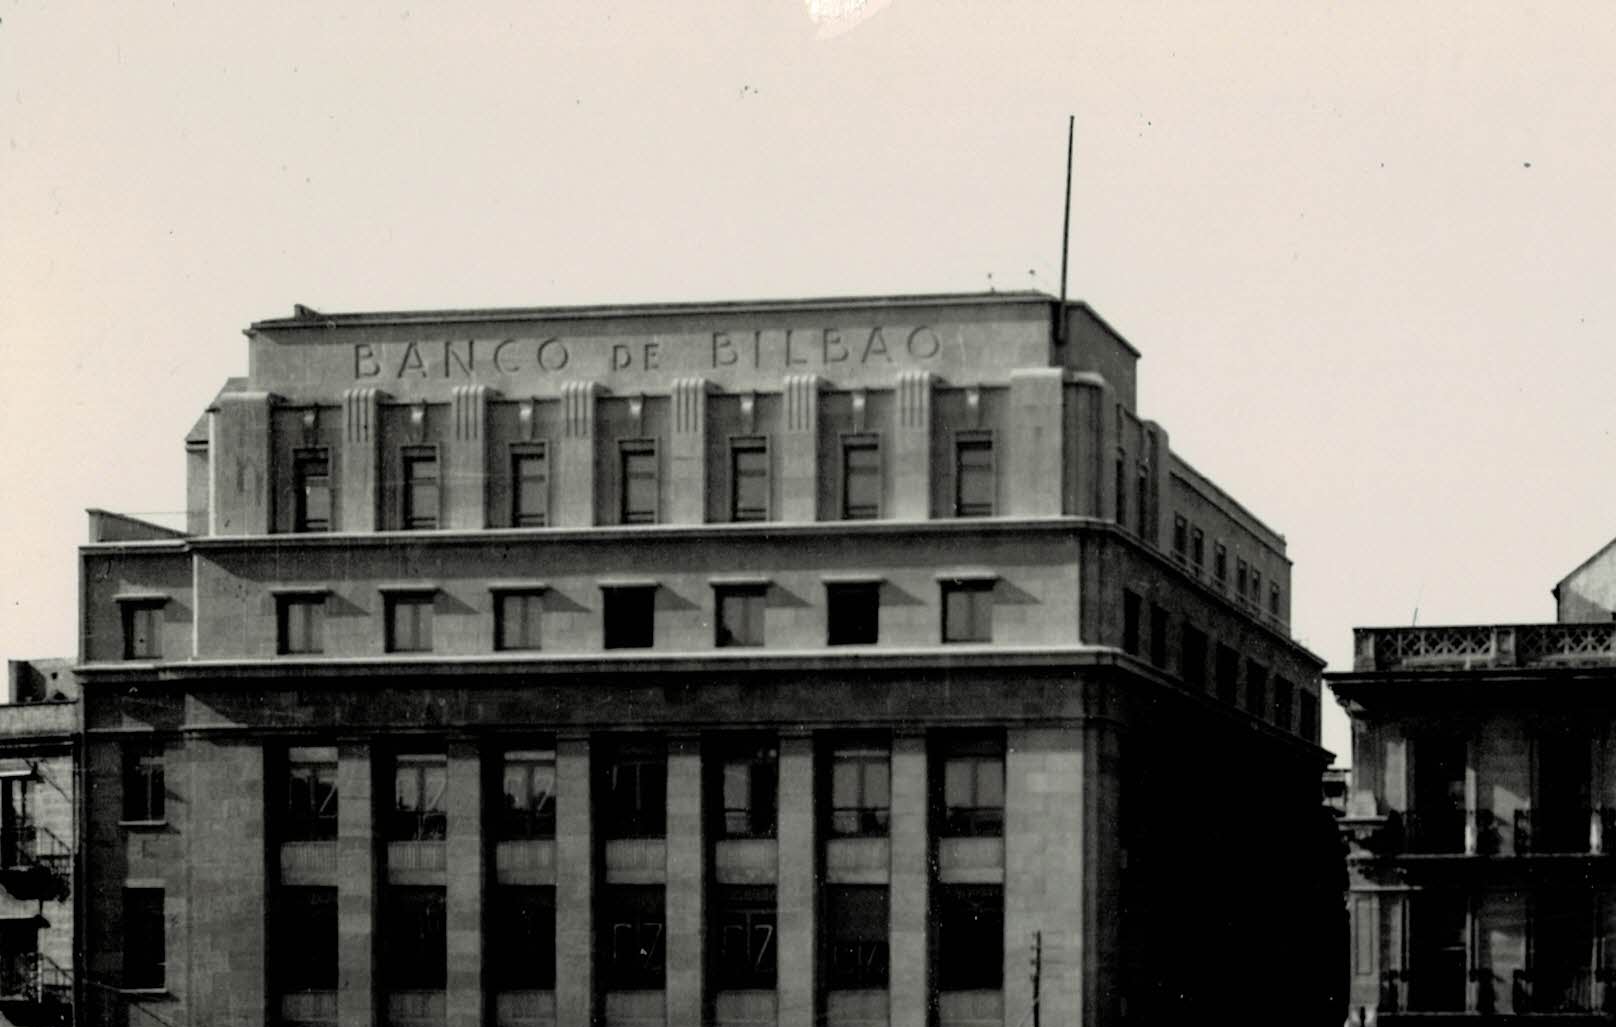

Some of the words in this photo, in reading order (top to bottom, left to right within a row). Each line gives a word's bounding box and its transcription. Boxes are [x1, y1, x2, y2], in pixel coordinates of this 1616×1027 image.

[354, 337, 569, 379] BANCO
[612, 343, 660, 372] DE
[712, 325, 941, 368] BILBAO
